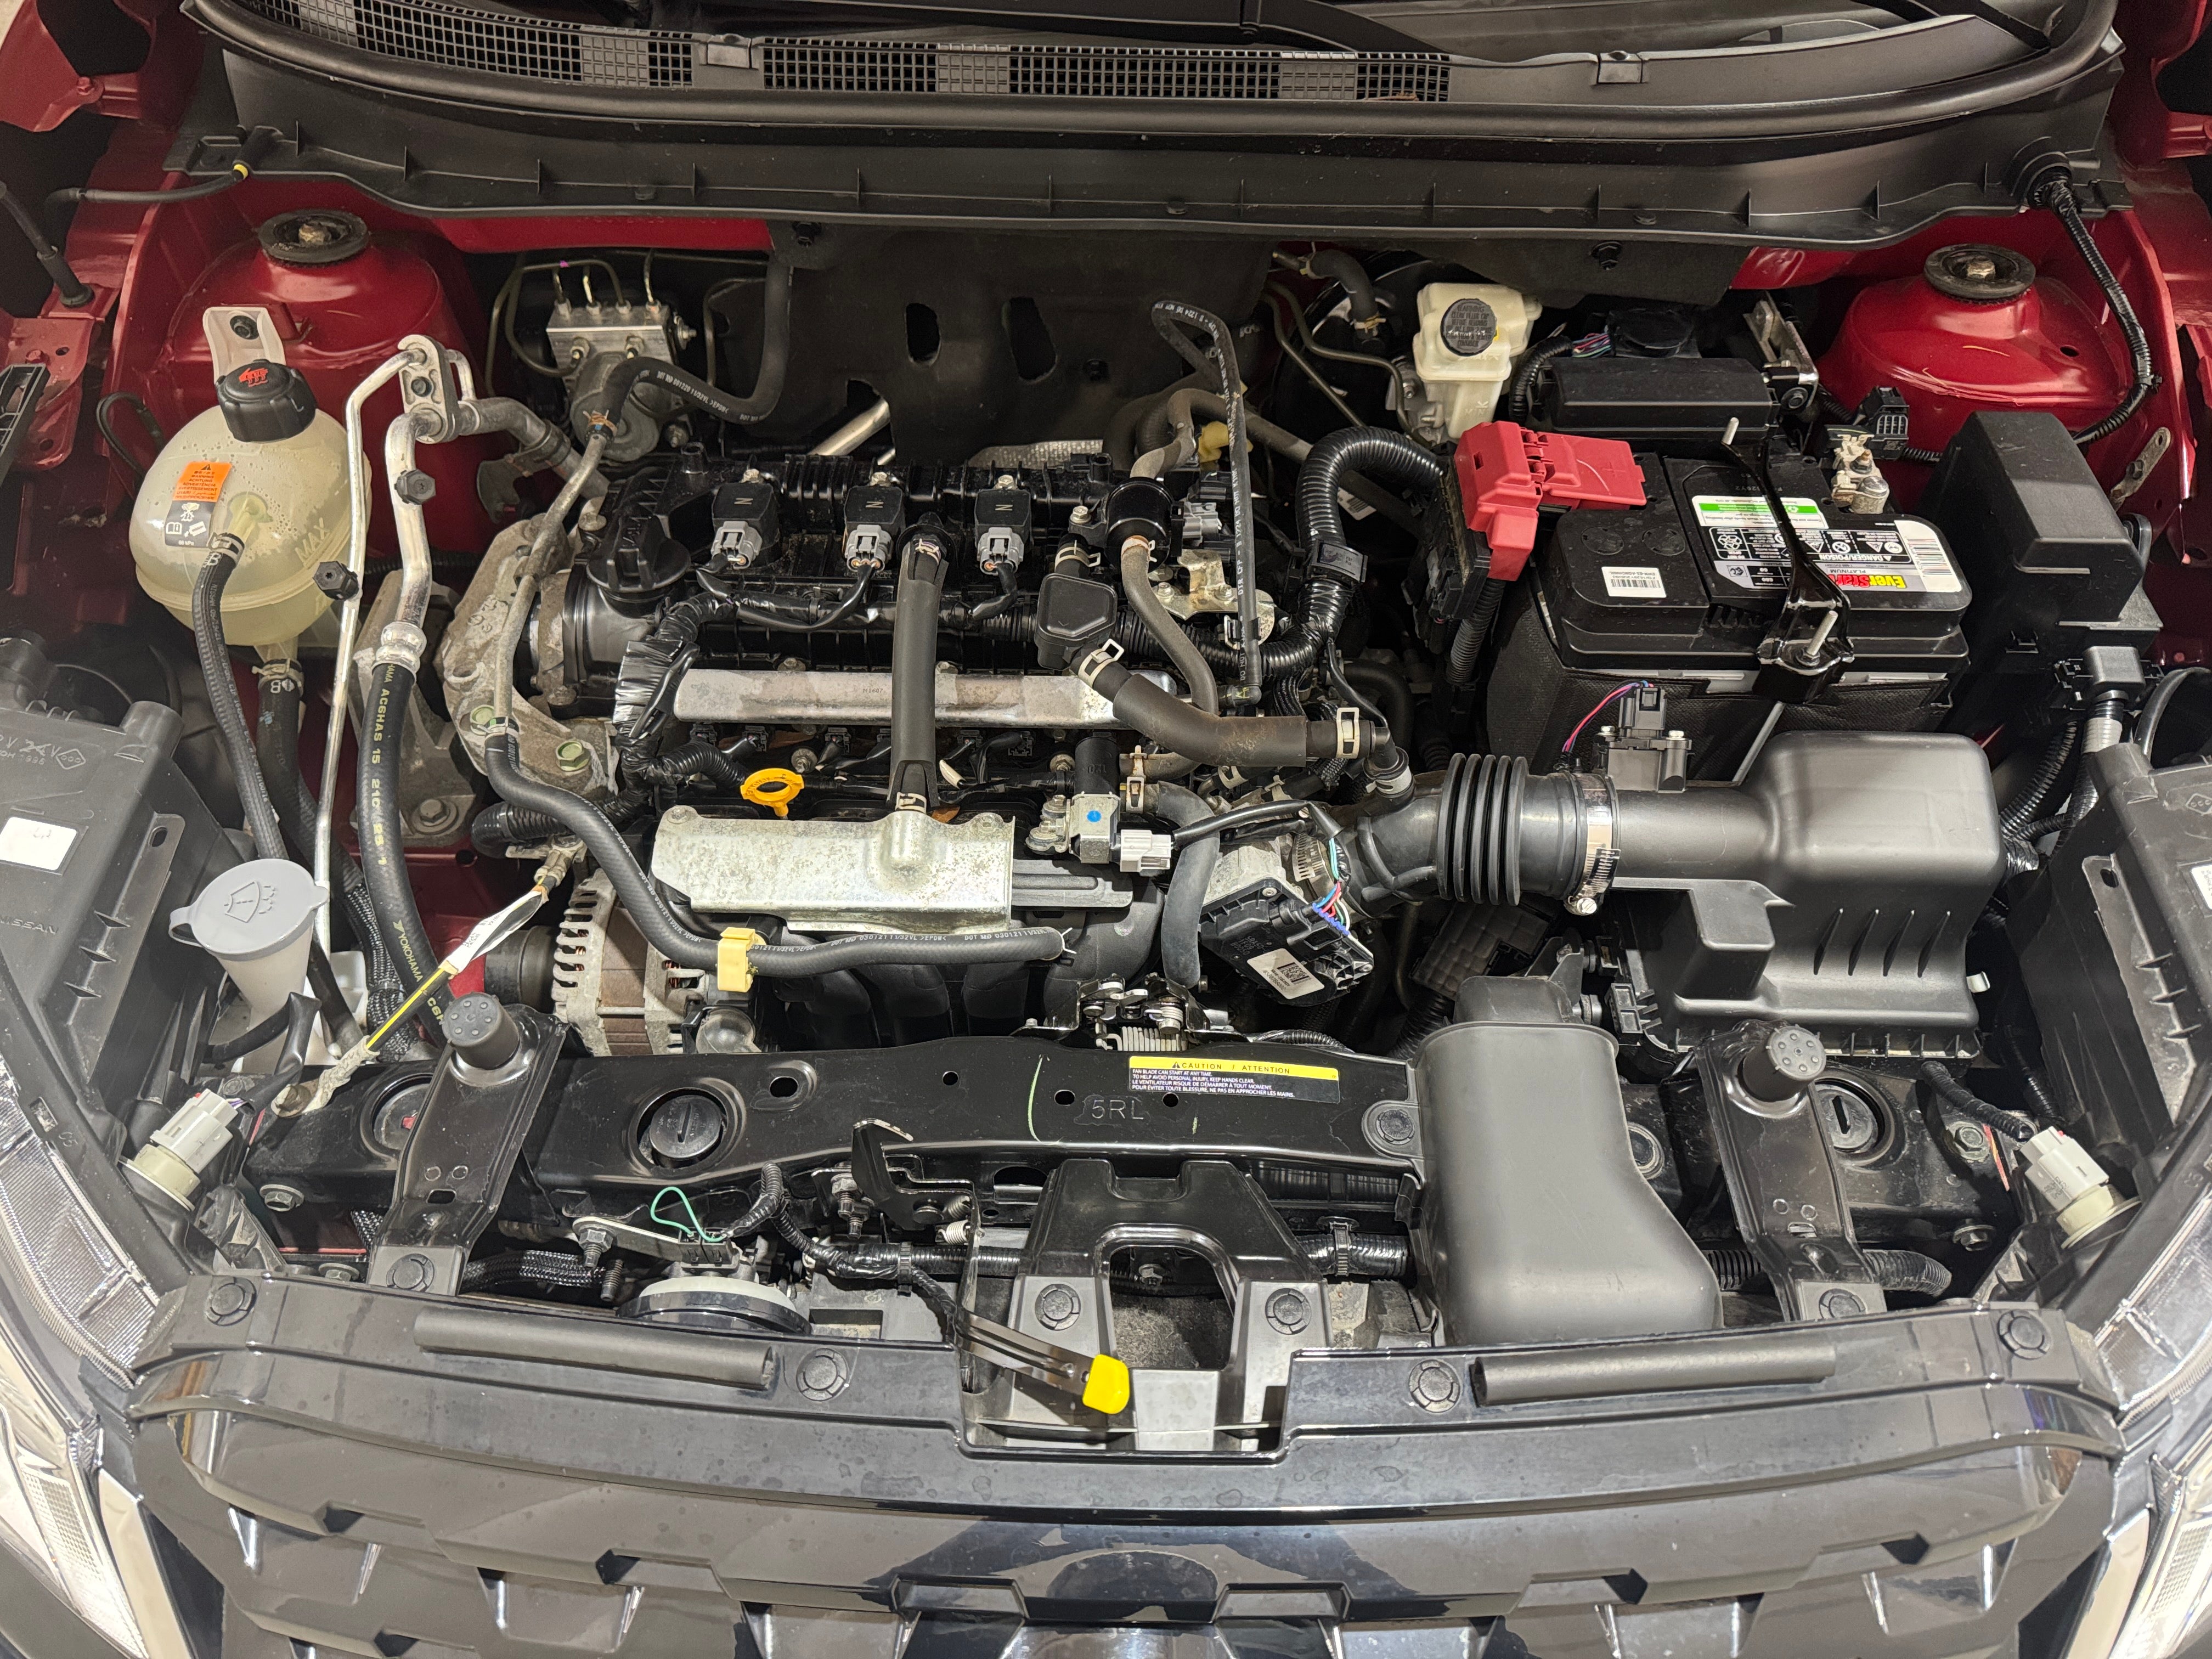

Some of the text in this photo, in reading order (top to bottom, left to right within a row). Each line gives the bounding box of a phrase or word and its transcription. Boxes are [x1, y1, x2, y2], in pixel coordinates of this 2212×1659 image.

[371, 748, 382, 765] 15
[398, 932, 424, 983] YOKOHAMA
[1242, 1065, 1290, 1074] ATTENTION
[1092, 1099, 1144, 1120] 5RL
